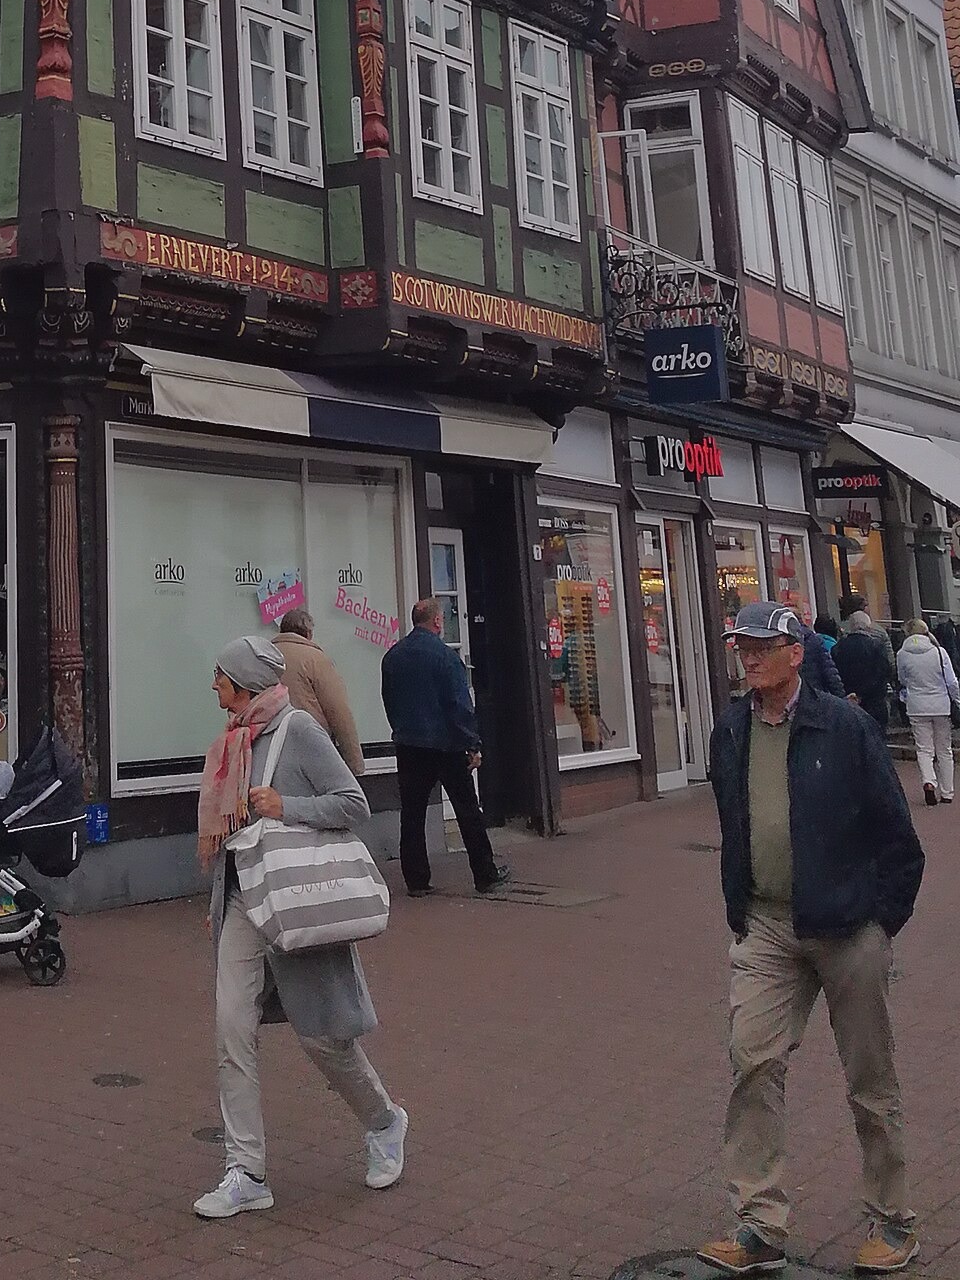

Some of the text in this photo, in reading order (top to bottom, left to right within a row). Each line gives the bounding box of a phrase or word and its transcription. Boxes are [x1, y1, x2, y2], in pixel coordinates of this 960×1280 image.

[145, 231, 243, 282] ERNEVERT
[651, 344, 712, 372] arko
[129, 396, 153, 415] Mark
[155, 558, 185, 581] arko
[235, 561, 262, 583] arko
[338, 563, 363, 584] arko
[335, 586, 388, 629] Backen
[354, 625, 369, 641] mit
